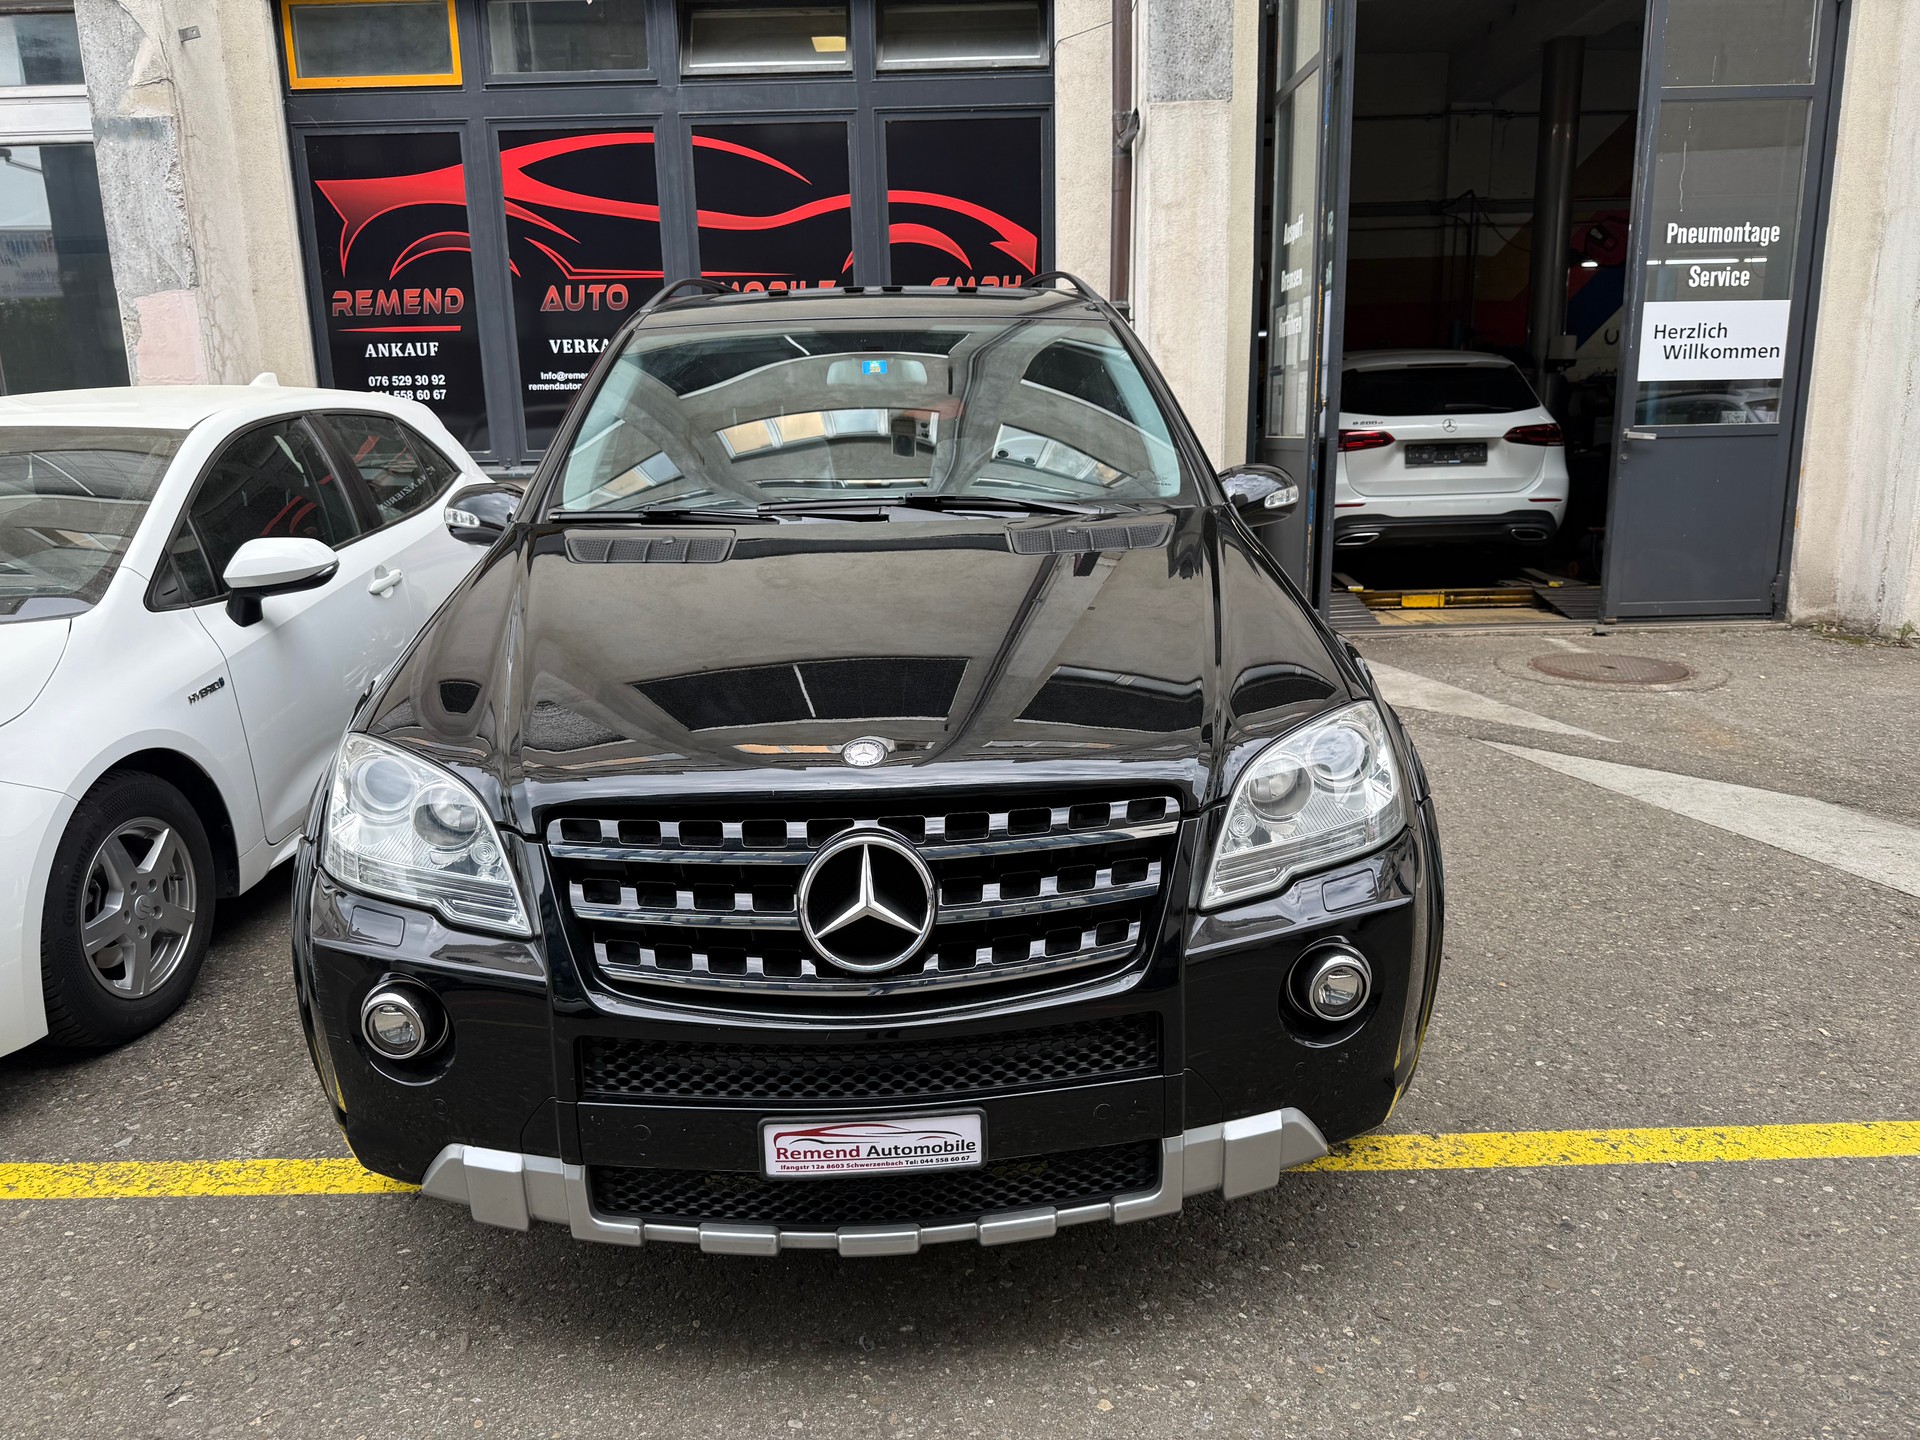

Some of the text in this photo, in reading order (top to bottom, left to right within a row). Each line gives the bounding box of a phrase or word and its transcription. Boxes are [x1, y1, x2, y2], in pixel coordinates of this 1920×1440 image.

[1666, 222, 1781, 246] Pneumontage
[1688, 265, 1750, 287] Service
[332, 284, 629, 317] REMEND AUTO
[1653, 322, 1728, 340] Herzlich
[365, 341, 440, 358] ANKAUF
[1663, 344, 1780, 360] Willkommen
[368, 374, 446, 387] 076 529 30 92
[416, 389, 431, 400] 60
[432, 389, 447, 400] 67
[775, 1139, 976, 1160] Remend Automobile
